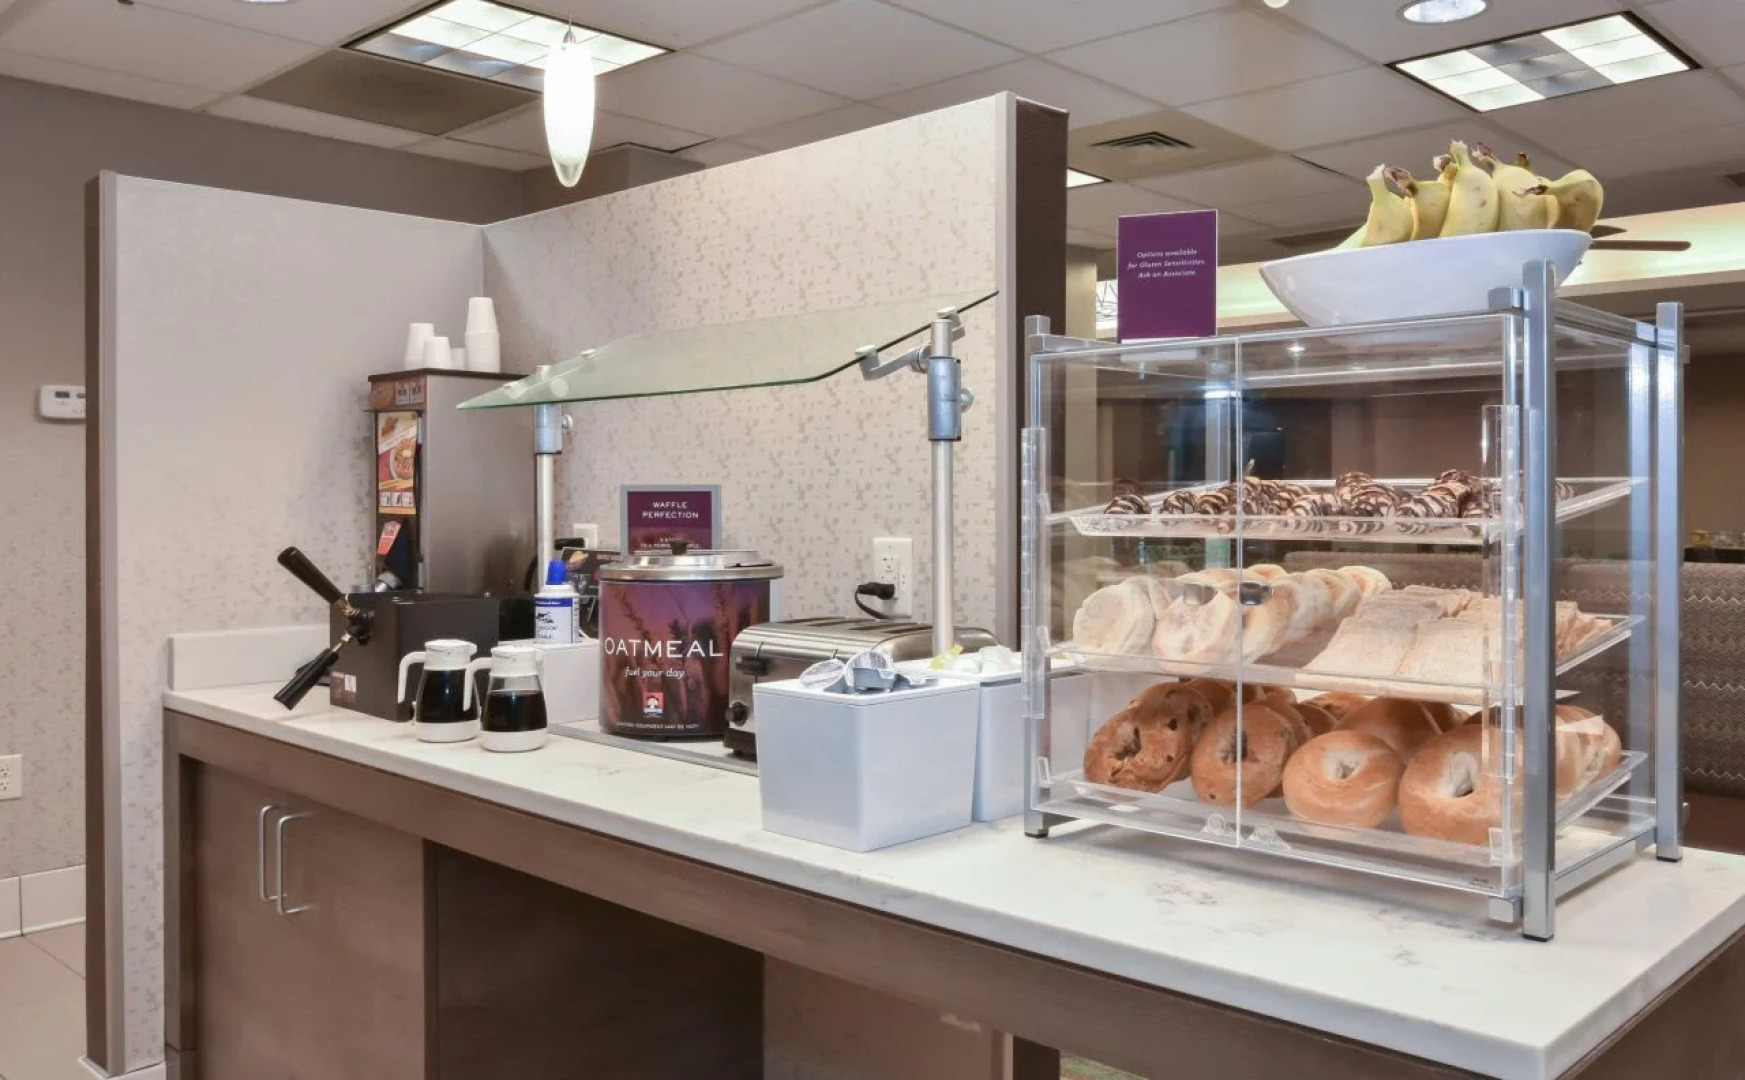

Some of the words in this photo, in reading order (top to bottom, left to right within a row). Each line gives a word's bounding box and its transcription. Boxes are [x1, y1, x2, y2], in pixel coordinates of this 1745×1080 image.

[1136, 251, 1164, 259] Options
[1165, 248, 1198, 256] available
[1126, 262, 1138, 271] for
[1137, 271, 1150, 279] Ask
[652, 501, 688, 509] WAFFLE
[642, 511, 699, 519] PERFECTION
[604, 637, 724, 658] OATMEAL
[625, 666, 640, 677] fuel
[641, 669, 663, 679] your
[666, 667, 685, 679] day
